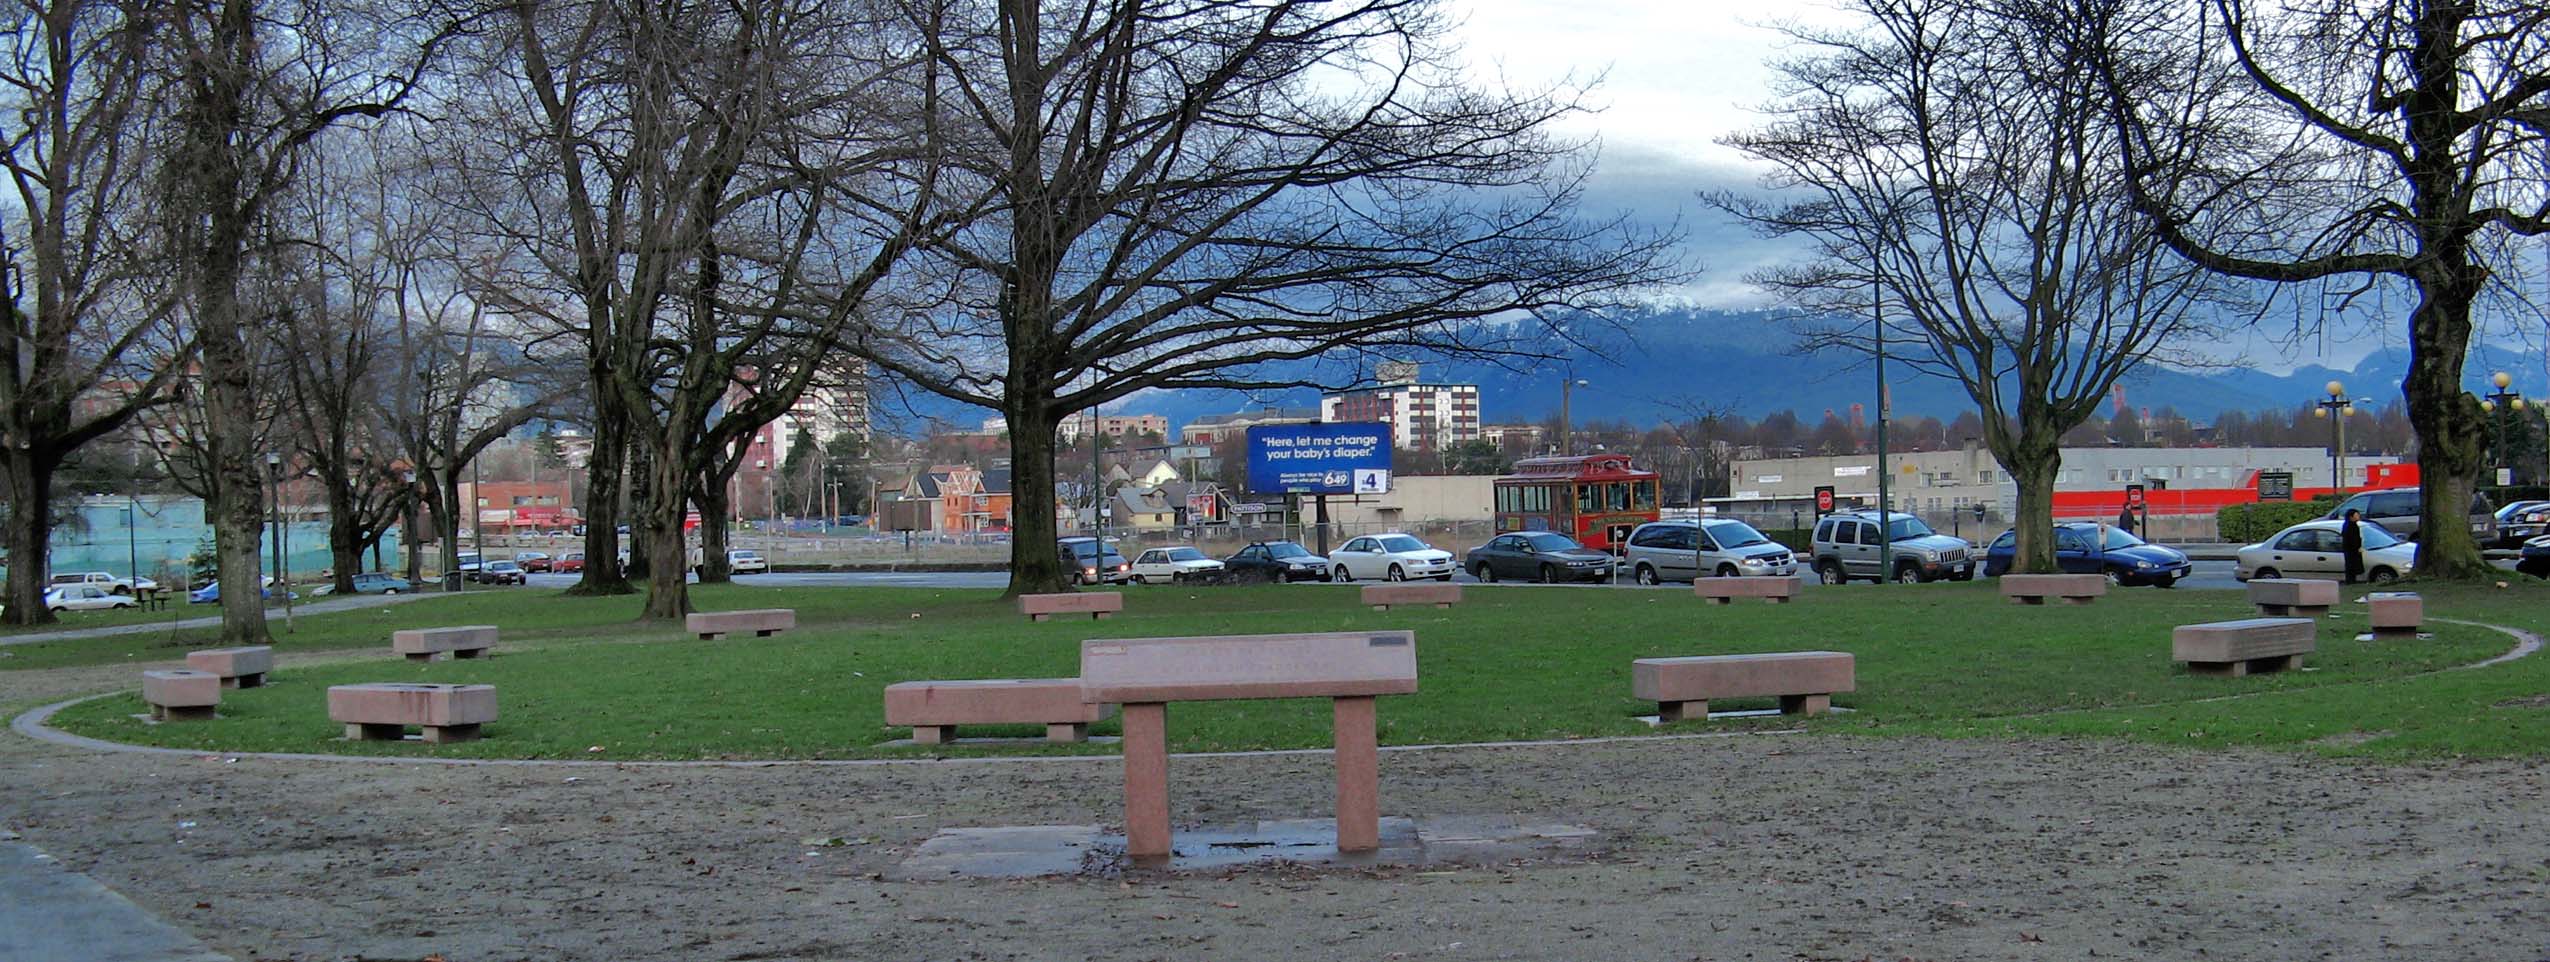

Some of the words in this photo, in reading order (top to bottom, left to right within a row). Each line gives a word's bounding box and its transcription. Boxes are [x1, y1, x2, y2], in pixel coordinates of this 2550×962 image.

[1297, 436, 1311, 446] let
[1313, 438, 1332, 446] me
[1334, 435, 1377, 447] change
[1266, 450, 1290, 461] your
[1294, 448, 1330, 460] baby's
